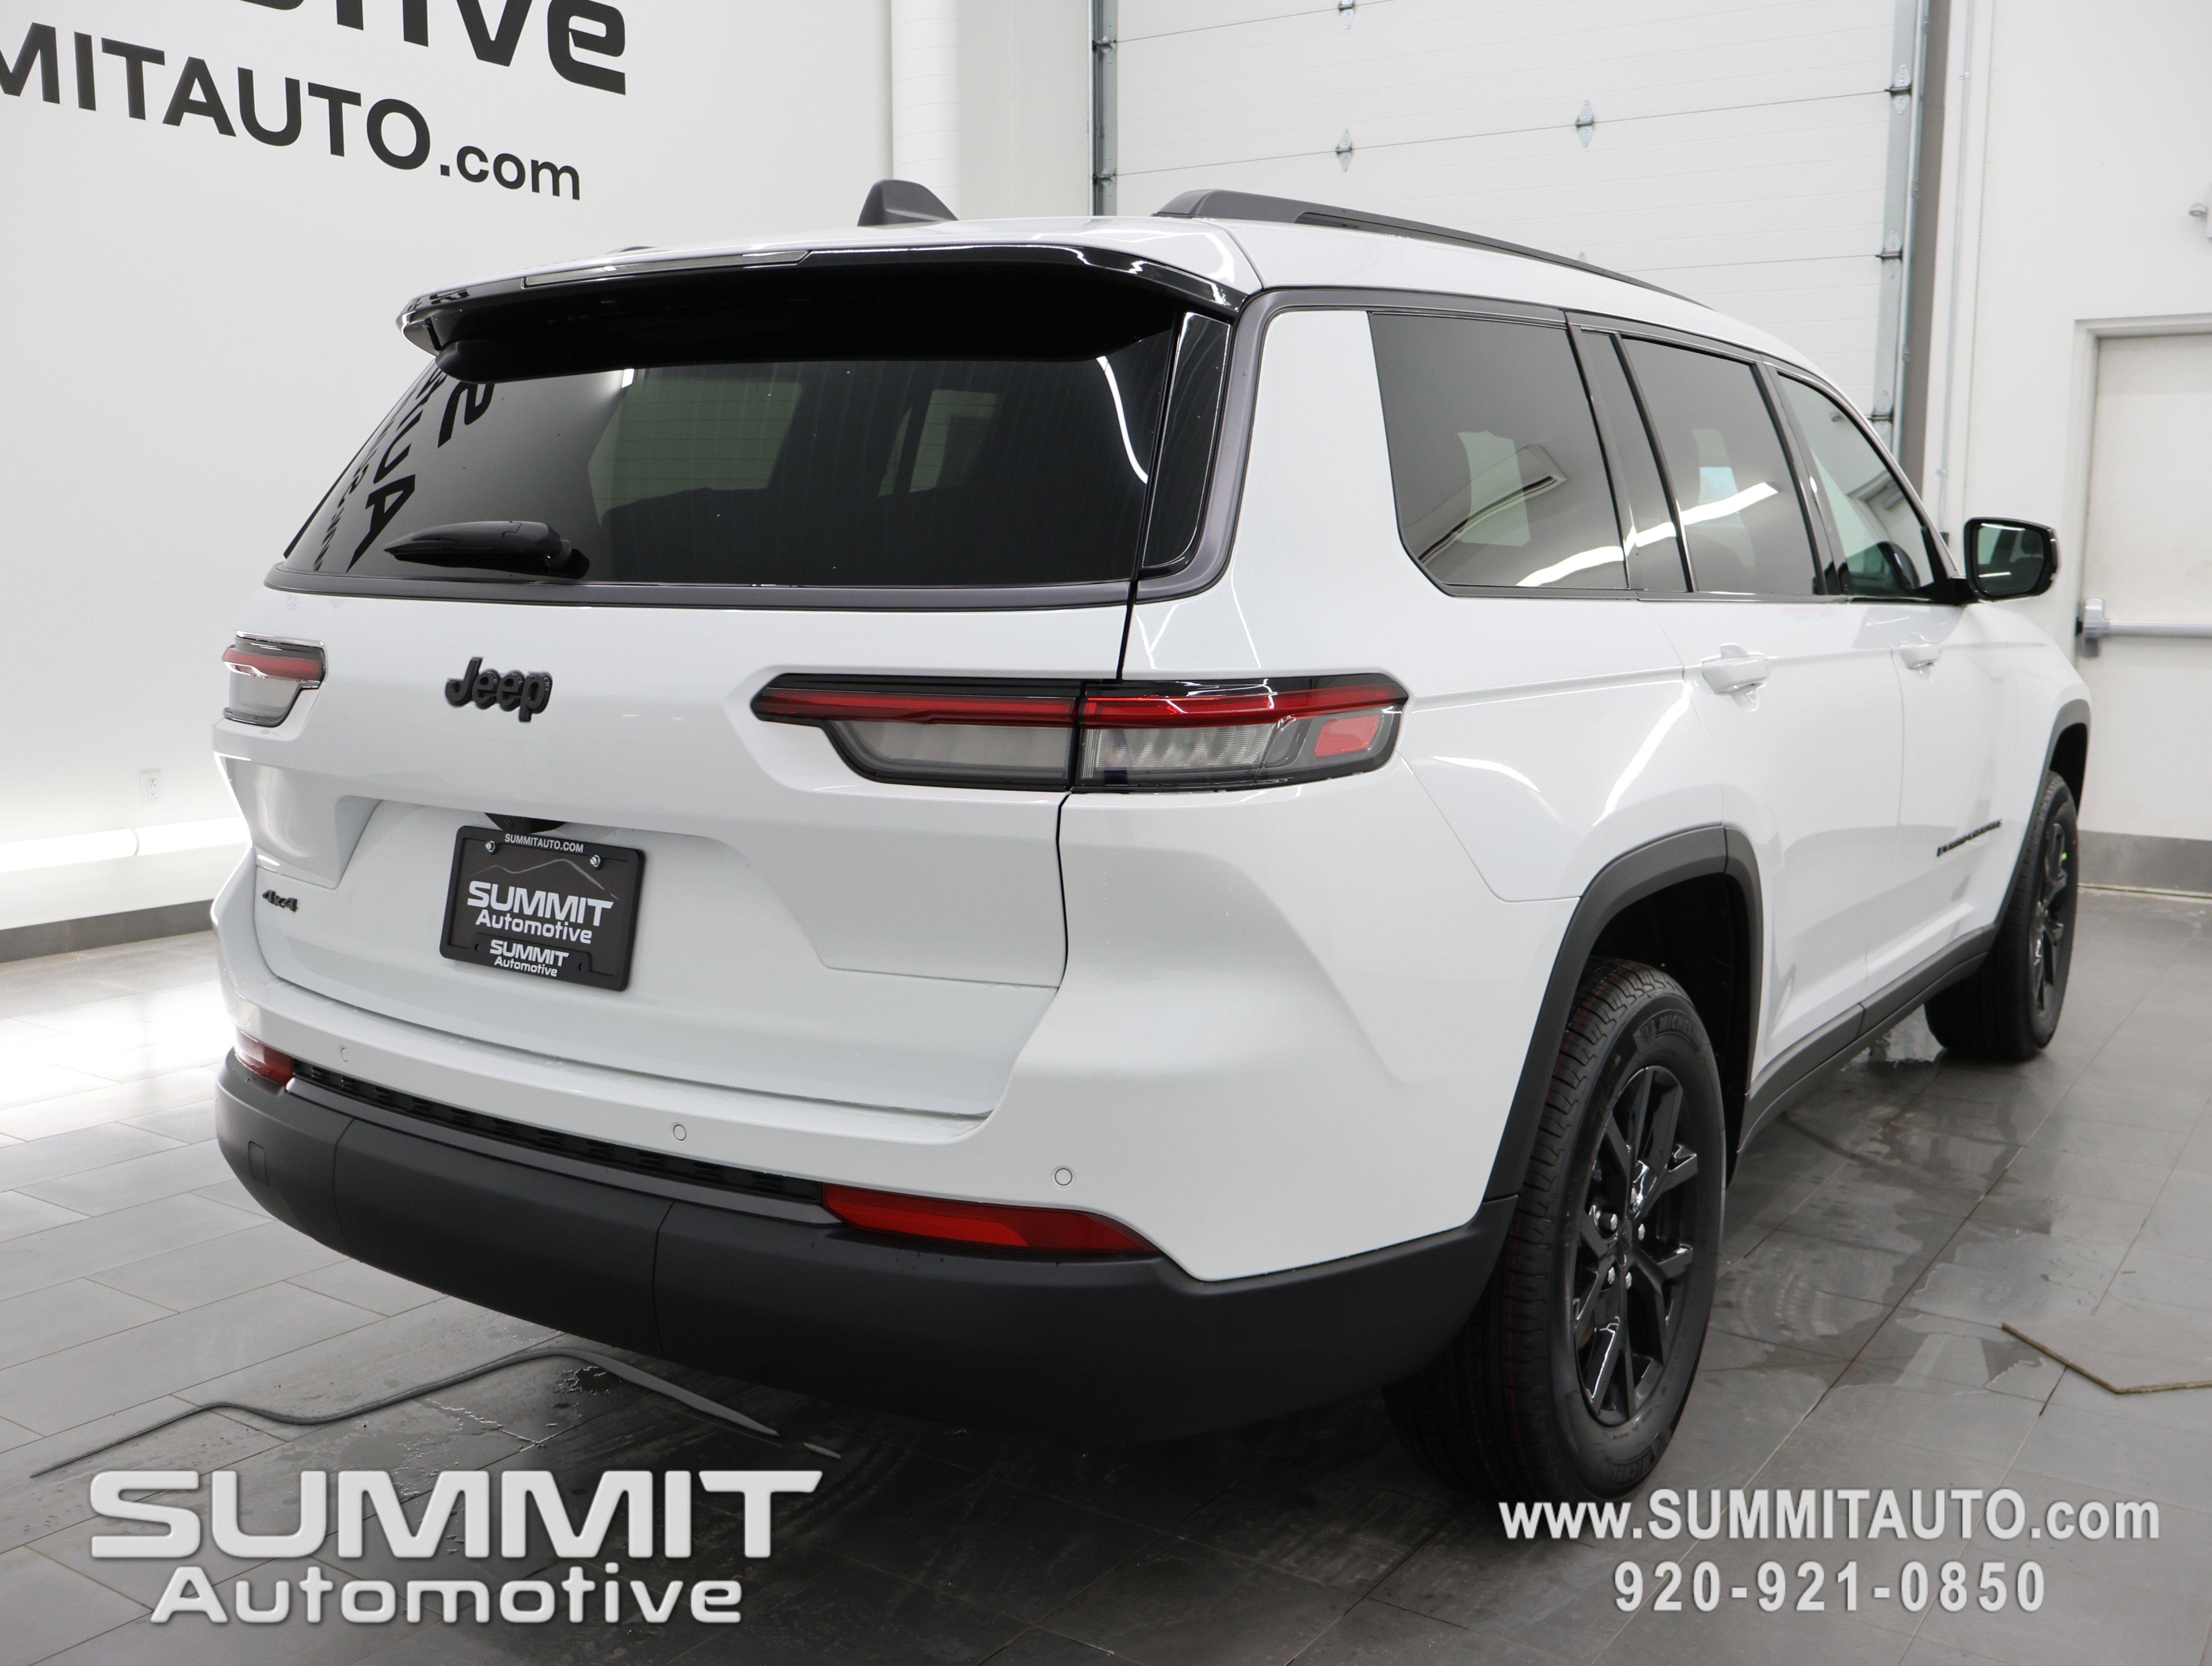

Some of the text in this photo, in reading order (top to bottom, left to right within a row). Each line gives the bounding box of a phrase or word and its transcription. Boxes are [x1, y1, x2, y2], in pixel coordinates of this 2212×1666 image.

[444, 656, 553, 723] Jeep
[504, 833, 584, 853] SUMMITAUTO.COM
[262, 890, 299, 913] 4x4
[467, 880, 614, 926] SUMMIT
[475, 909, 592, 944] Automotive
[489, 939, 570, 966] SUMMIT
[494, 956, 558, 977] Automotive
